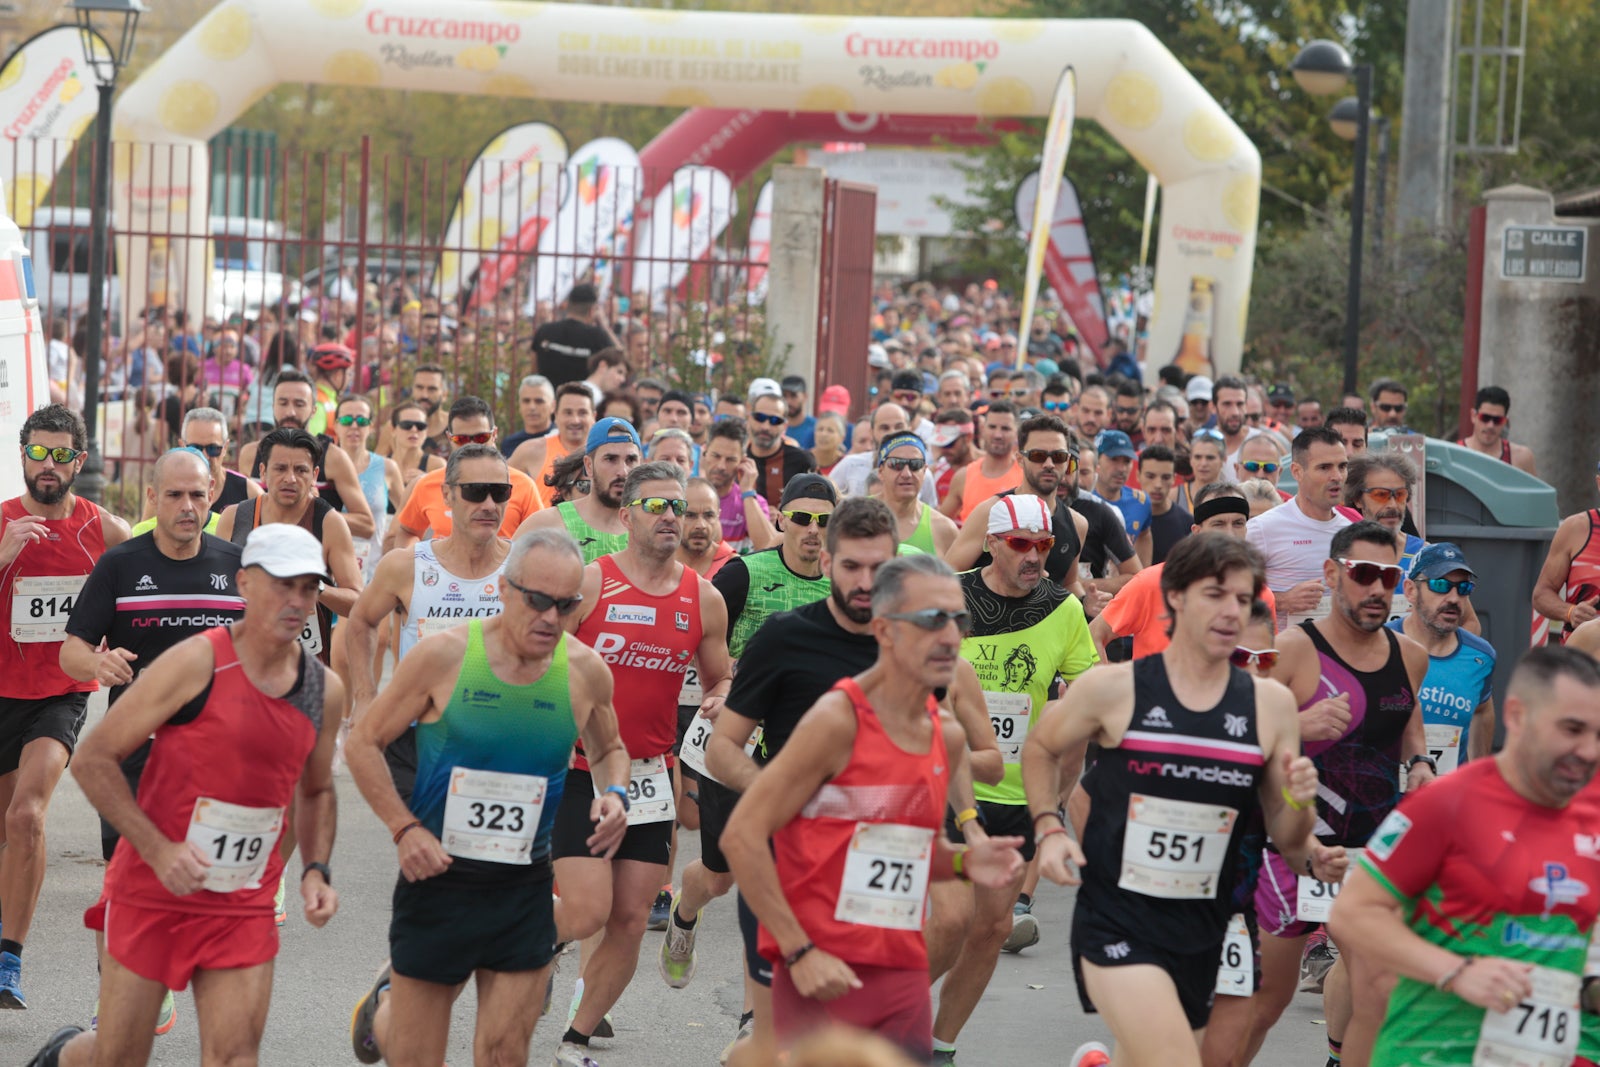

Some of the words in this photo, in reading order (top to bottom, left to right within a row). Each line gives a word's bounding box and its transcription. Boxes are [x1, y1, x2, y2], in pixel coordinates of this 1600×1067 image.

[366, 9, 521, 44] Cruzcampo
[844, 33, 1000, 62] Cruzcampo
[1531, 232, 1577, 246] CALLE
[30, 596, 74, 618] 814
[630, 641, 671, 655] Clínicas
[976, 644, 998, 660] XI
[468, 802, 524, 832] 323
[213, 834, 263, 862] 119
[1148, 831, 1205, 863] 551
[868, 860, 913, 892] 275
[1516, 1003, 1568, 1043] 718
